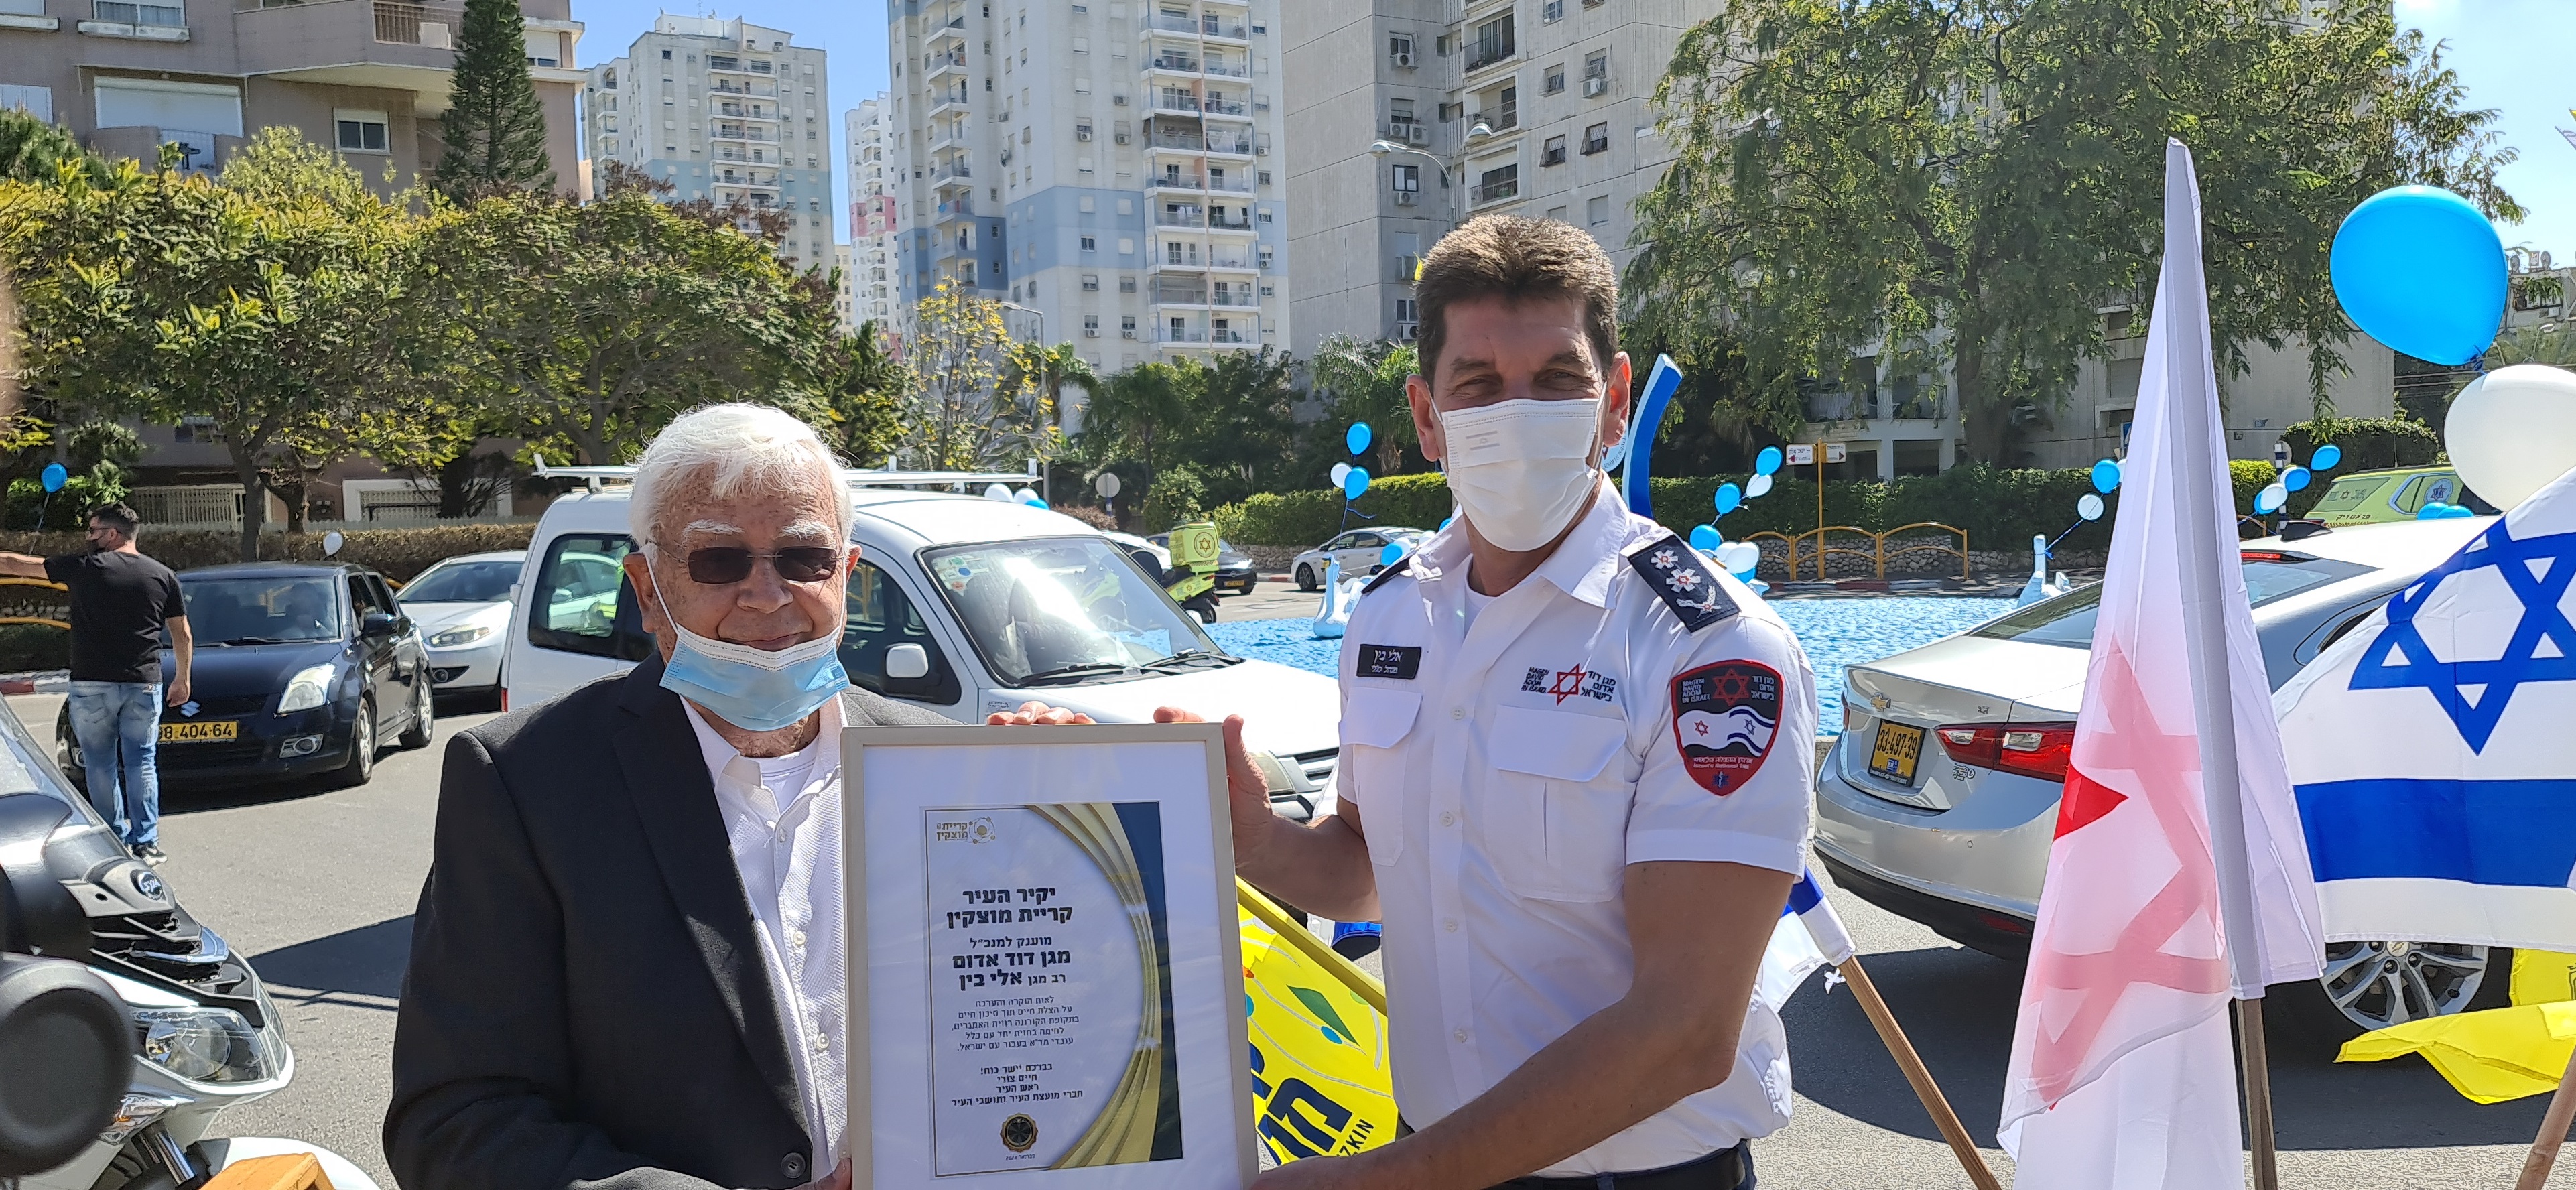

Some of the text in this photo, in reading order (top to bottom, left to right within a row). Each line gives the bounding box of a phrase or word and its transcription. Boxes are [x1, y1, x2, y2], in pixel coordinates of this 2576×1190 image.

[1374, 649, 1403, 664] אלי בין
[1588, 671, 1616, 686] מגן דוד
[1592, 683, 1615, 694] אדום
[1580, 686, 1612, 702] בישראל
[937, 830, 968, 841] מוצקין
[962, 888, 1056, 905] יקיר העיר
[946, 907, 1072, 929] קריית מוצקין
[1017, 937, 1052, 949] מוענק
[953, 950, 1071, 969] מגן דוד אדום
[959, 968, 1066, 992] רב מגן אלי בין
[1008, 997, 1033, 1006] הוקרה
[1035, 996, 1055, 1005] לאות
[1002, 1009, 1015, 1018] תוך
[1017, 1008, 1035, 1016] חיים
[1038, 1006, 1059, 1015] הצלת
[1061, 1005, 1073, 1014] על
[979, 1010, 999, 1020] סיכון
[1015, 1017, 1046, 1026] הקורונה
[1049, 1016, 1080, 1024] בתקופת
[965, 1031, 980, 1040] כלל
[1014, 1029, 1037, 1037] בחזית
[1039, 1027, 1065, 1035] לחימה
[988, 1041, 1000, 1049] עם
[1003, 1039, 1027, 1048] בעבור
[1051, 1037, 1074, 1045] עובדי
[957, 1042, 986, 1051] ישראל.
[980, 1066, 999, 1075] כוח!
[1001, 1065, 1022, 1073] יישר
[997, 1074, 1037, 1083] חיים צורי
[996, 1083, 1039, 1094] ראש העיר
[976, 1097, 1007, 1105] ותושבי
[1009, 1095, 1030, 1103] העיר
[1033, 1093, 1060, 1101] מועצת
[952, 1098, 972, 1107] העיר
[1336, 1118, 1375, 1157] ZKIN
